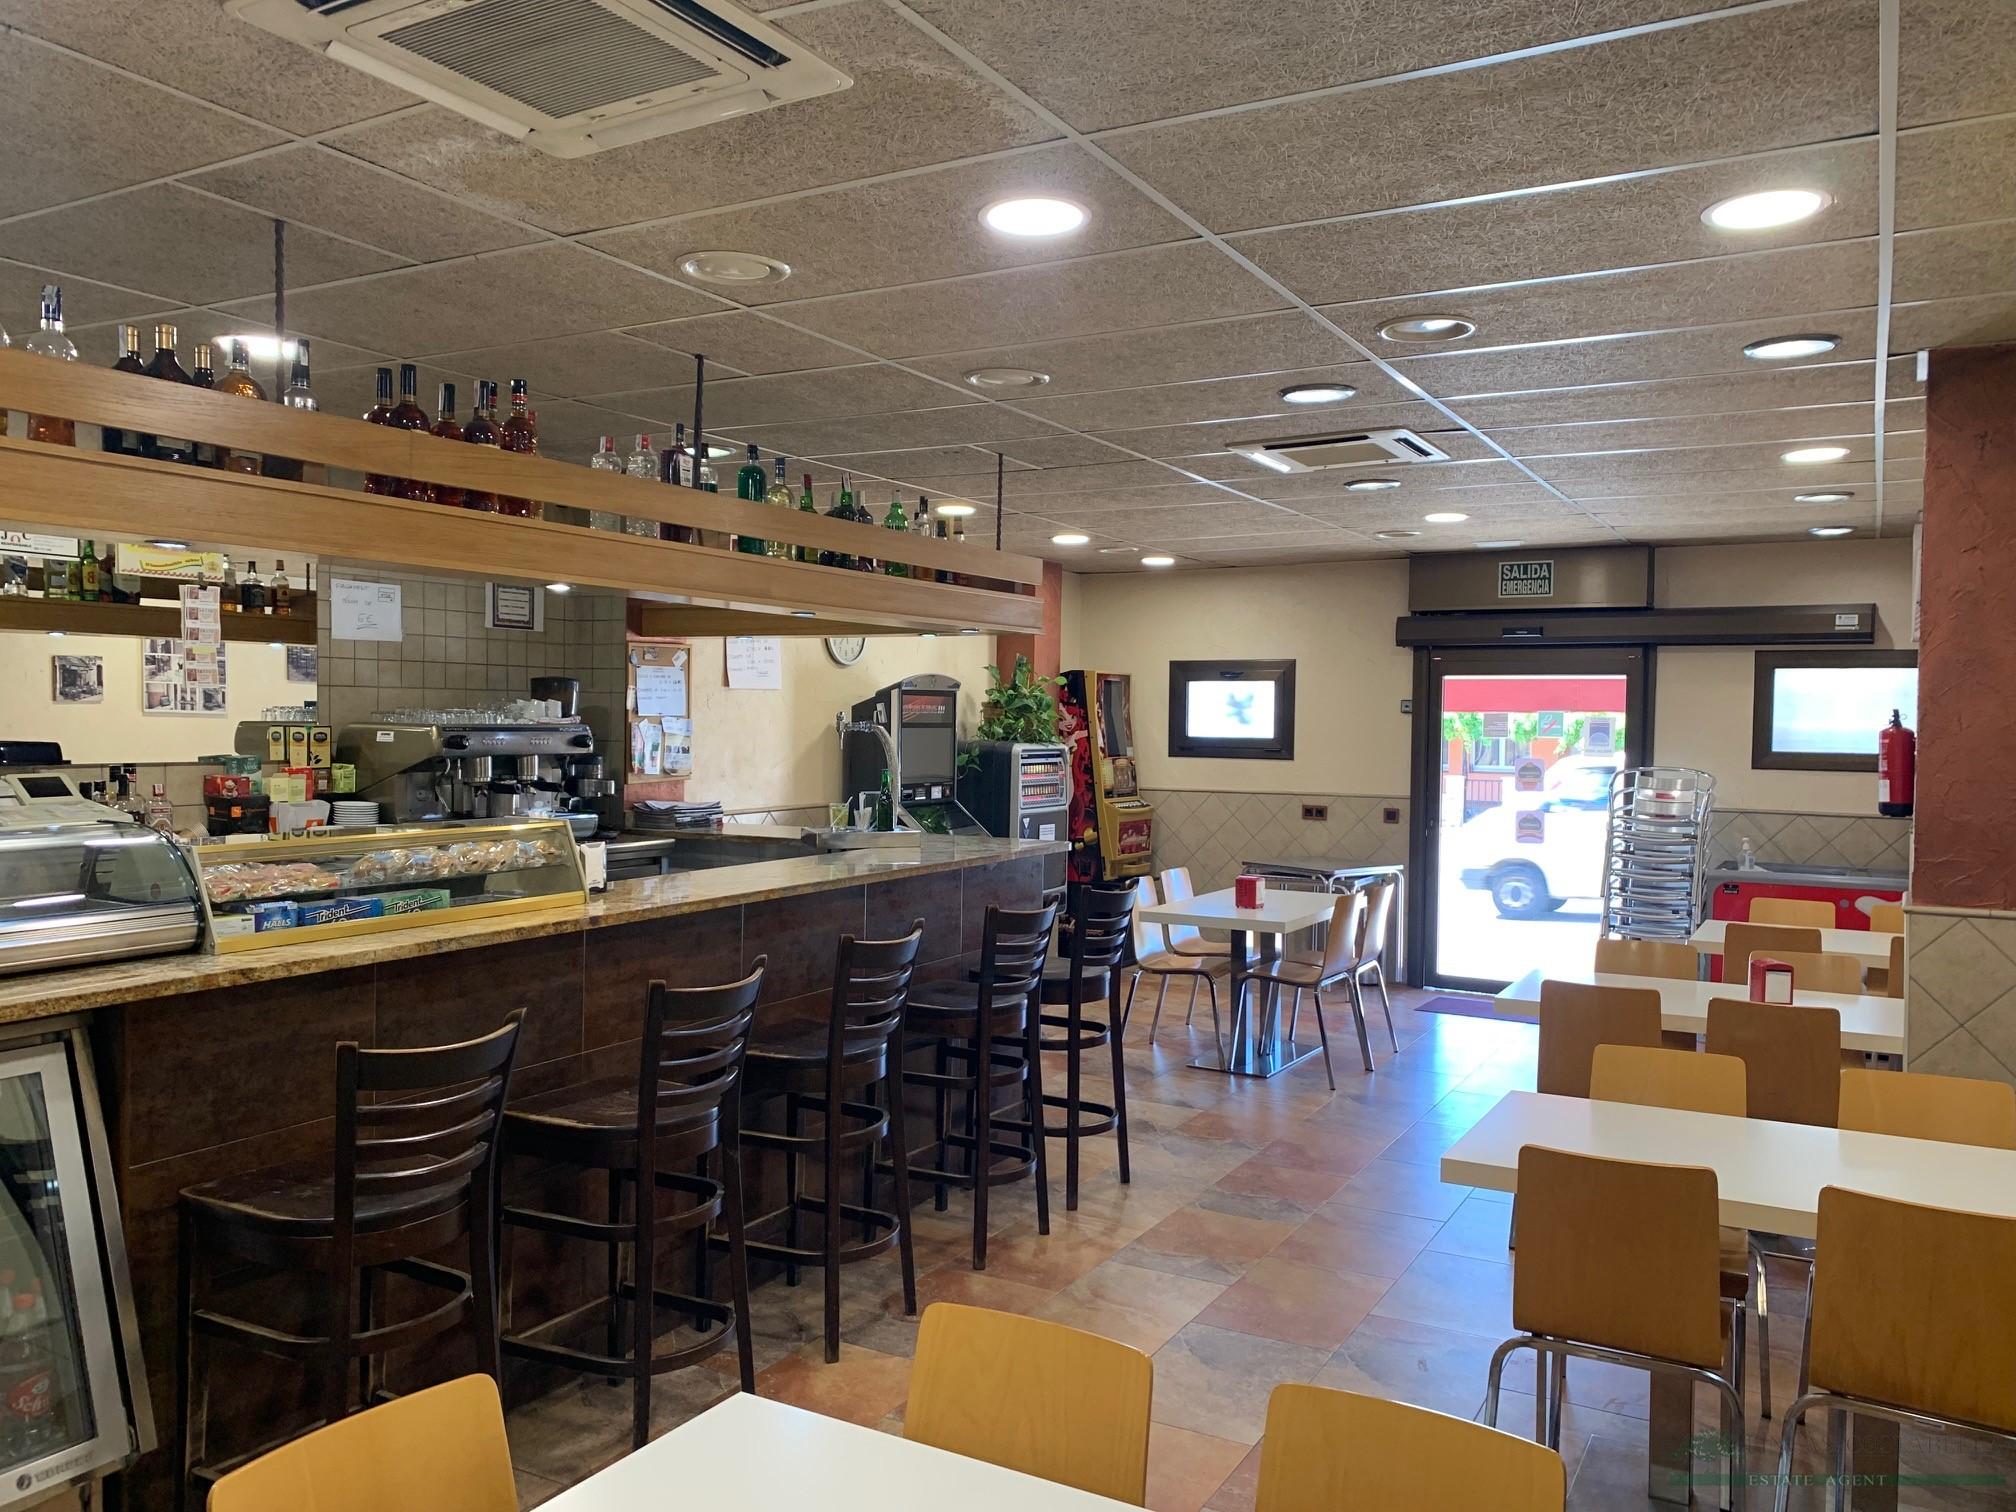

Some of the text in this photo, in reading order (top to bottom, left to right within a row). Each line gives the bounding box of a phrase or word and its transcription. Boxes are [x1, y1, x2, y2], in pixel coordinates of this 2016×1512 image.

[1503, 564, 1549, 579] SALIDA
[1502, 580, 1549, 594] EMERGENCIA
[394, 896, 423, 913] Trident
[316, 904, 350, 923] Trident
[262, 918, 292, 930] HALLS
